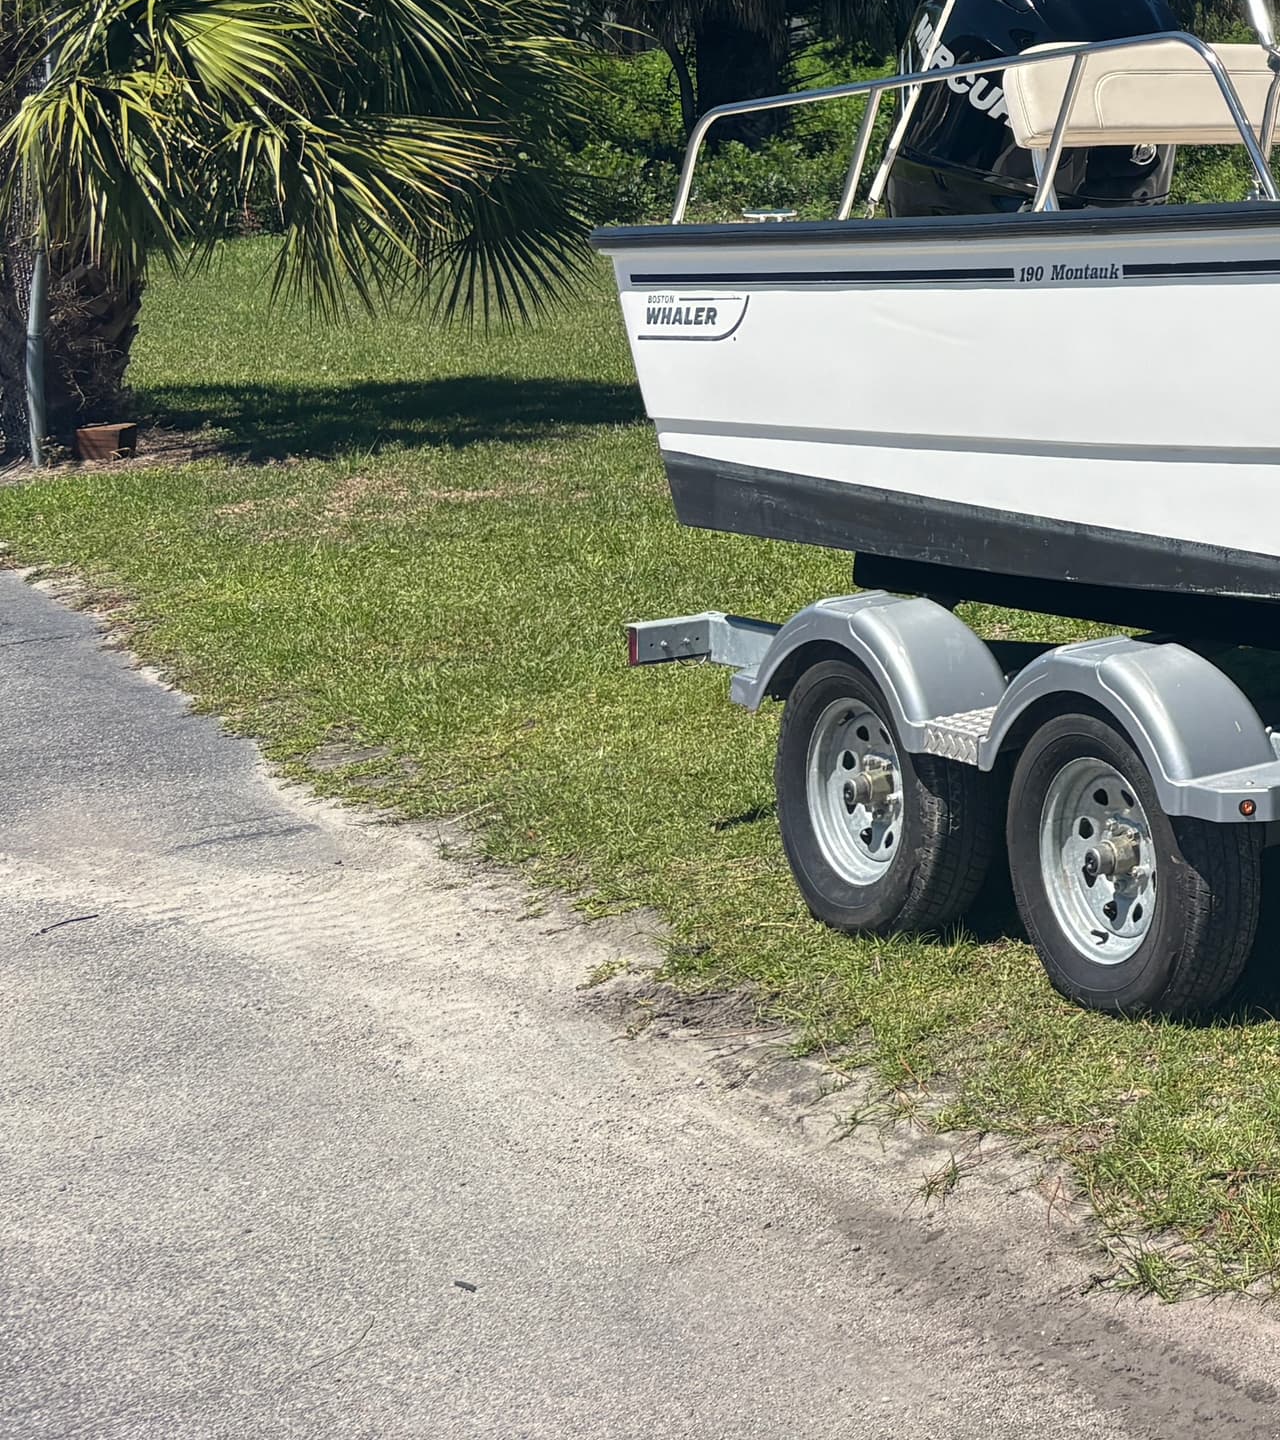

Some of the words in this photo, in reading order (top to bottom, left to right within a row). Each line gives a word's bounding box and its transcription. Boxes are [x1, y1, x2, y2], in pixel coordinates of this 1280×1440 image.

[914, 12, 1014, 129] MERCU
[1018, 265, 1045, 282] 190
[1050, 263, 1120, 281] Montauk
[647, 295, 675, 304] BOSTON
[646, 306, 718, 325] WHALER
